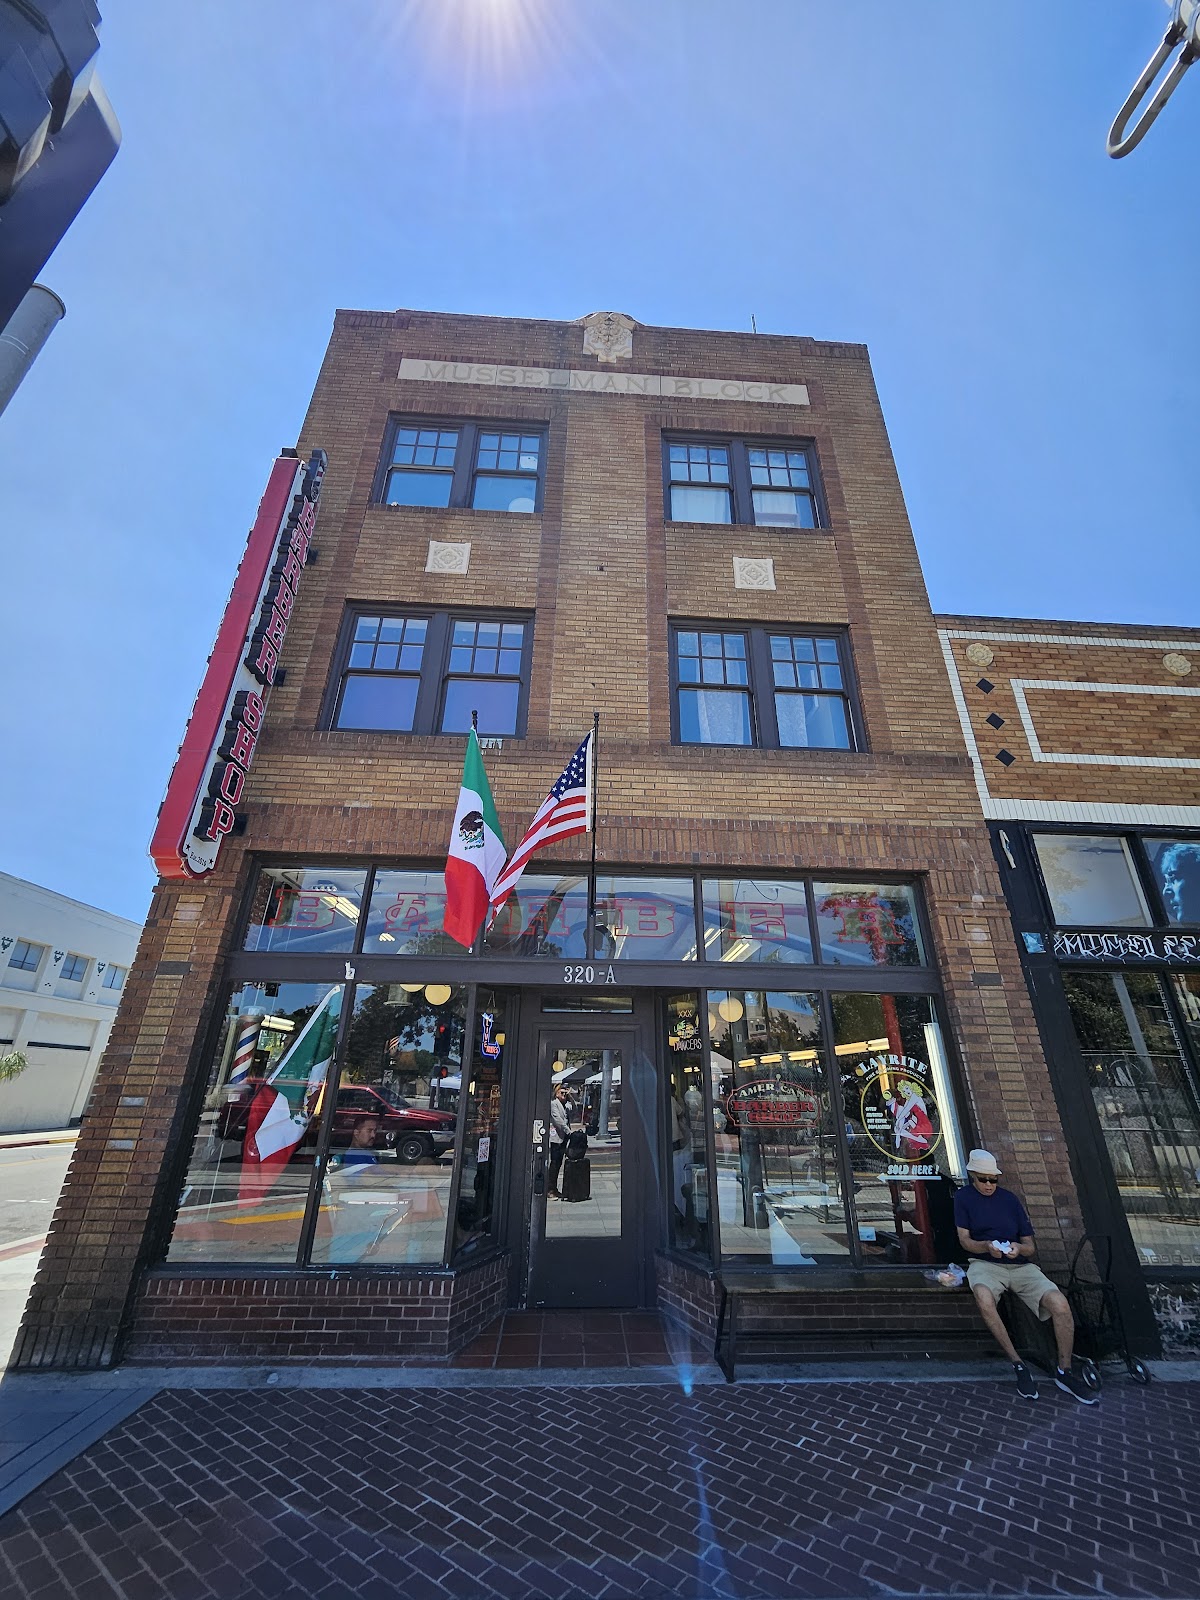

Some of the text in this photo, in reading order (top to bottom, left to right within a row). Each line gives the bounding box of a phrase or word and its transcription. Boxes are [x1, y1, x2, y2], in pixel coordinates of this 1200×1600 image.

[422, 362, 789, 402] MUSSELMAN BLOCK
[206, 496, 317, 842] BARBER SHOP
[674, 1038, 702, 1051] DANCERS
[858, 1054, 928, 1075] LAYRITE
[900, 1067, 925, 1083] PRODUCTS
[732, 1100, 816, 1111] BARBER
[747, 1111, 802, 1122] SHOP
[887, 1165, 909, 1175] SOLD
